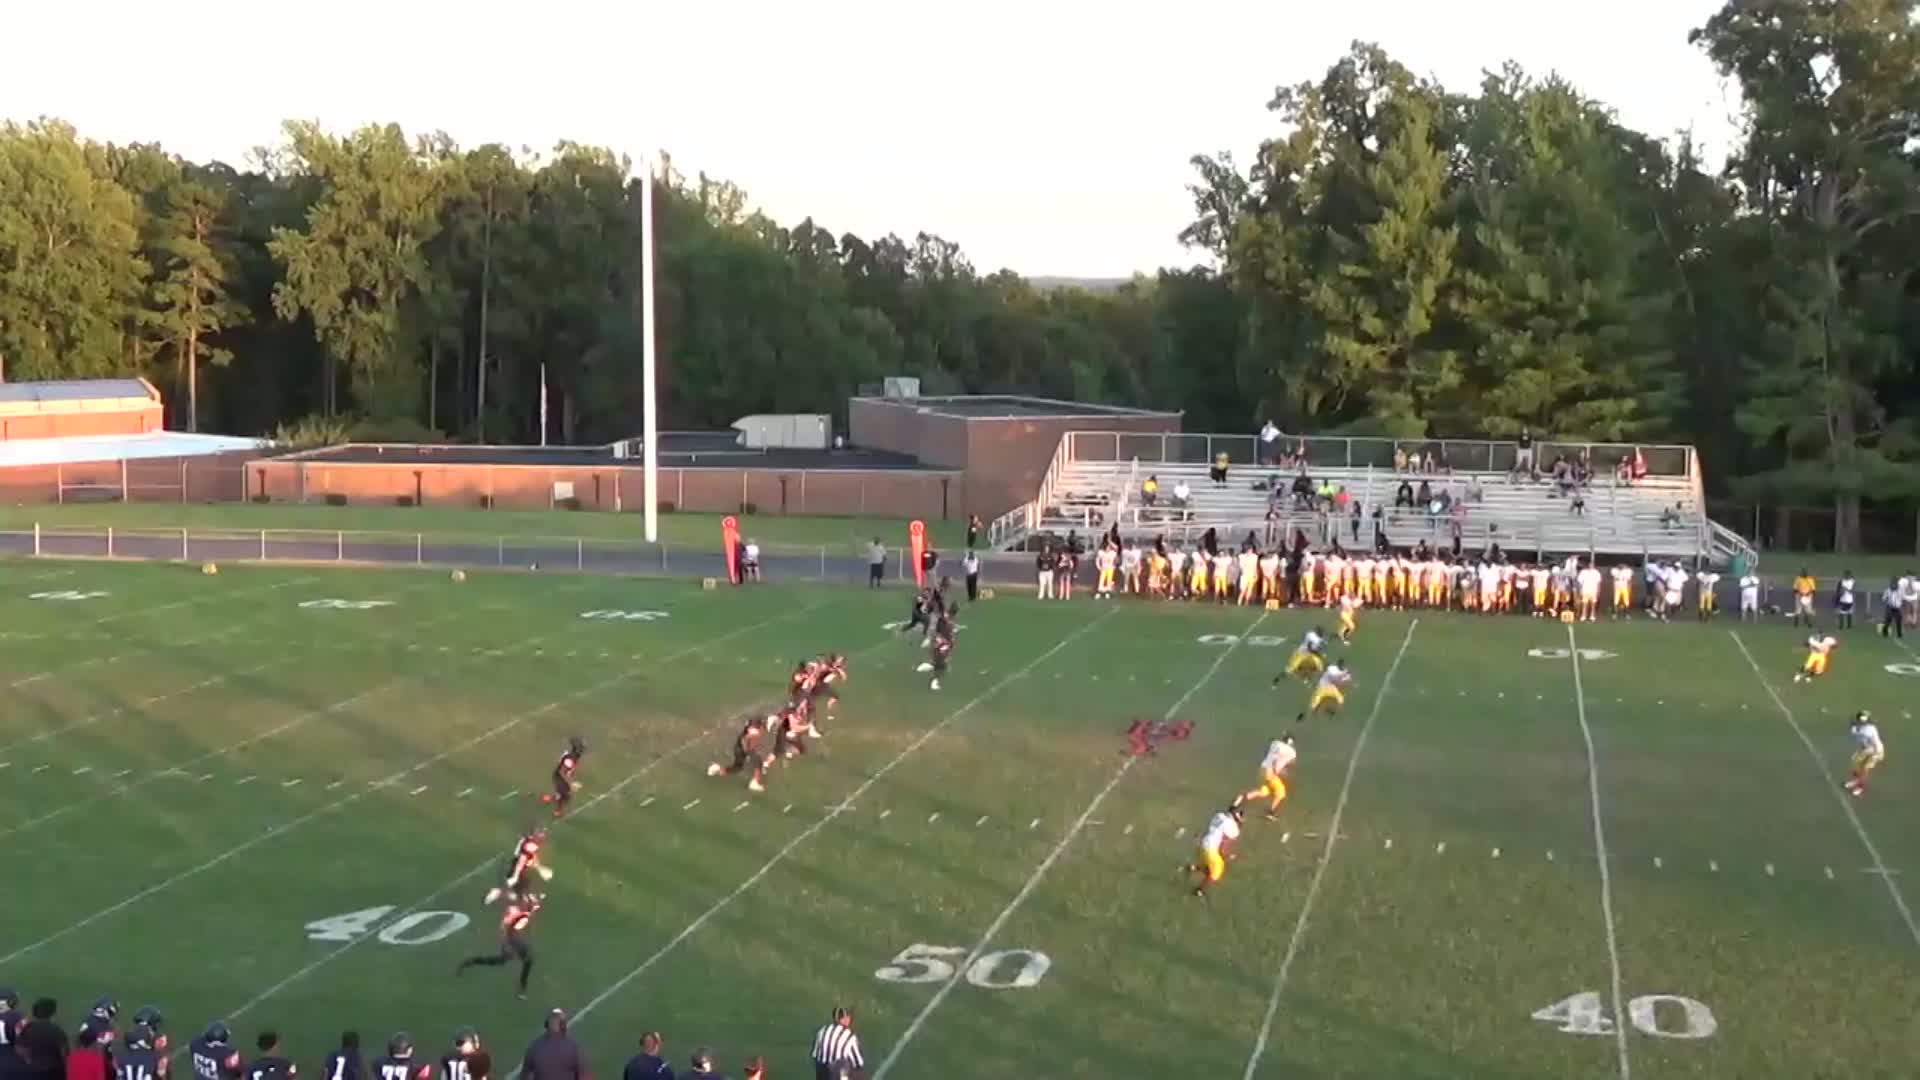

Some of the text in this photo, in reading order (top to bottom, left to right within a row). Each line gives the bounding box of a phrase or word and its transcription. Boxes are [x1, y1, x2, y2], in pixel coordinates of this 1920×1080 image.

[303, 905, 470, 945] 40
[875, 943, 1051, 989] 50
[1531, 991, 1718, 1038] 40
